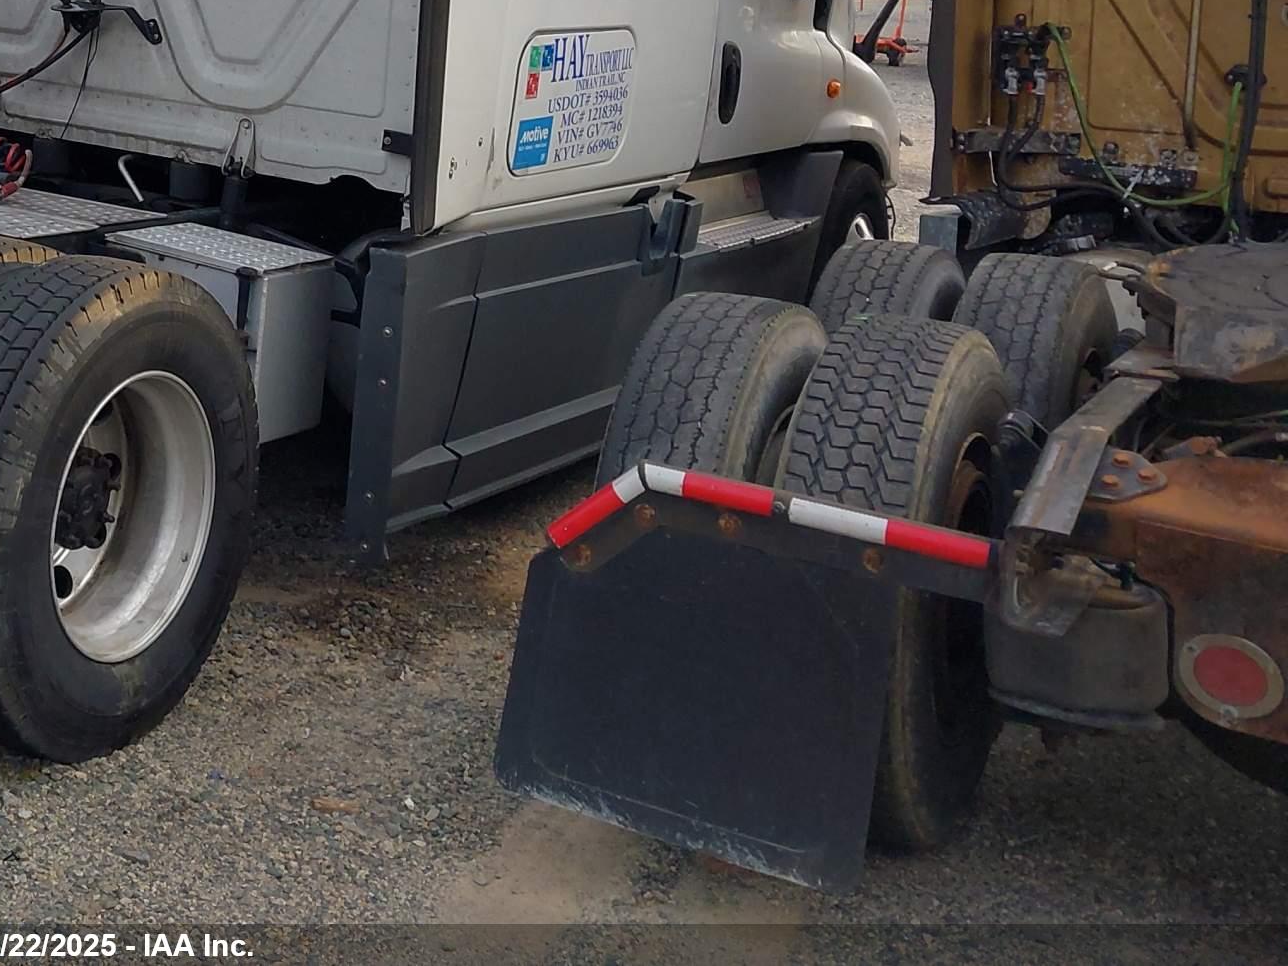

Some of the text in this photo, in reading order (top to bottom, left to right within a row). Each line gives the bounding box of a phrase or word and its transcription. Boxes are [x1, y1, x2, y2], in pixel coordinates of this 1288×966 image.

[551, 34, 635, 82] HAY TRANSPORT LLC
[575, 77, 598, 92] INDIAN
[548, 85, 629, 114] USDOT# 3594036
[560, 101, 624, 128] MC# 1218394
[558, 118, 624, 145] VIN# GV7746
[553, 144, 584, 163] KYU#
[587, 135, 619, 155] 669963
